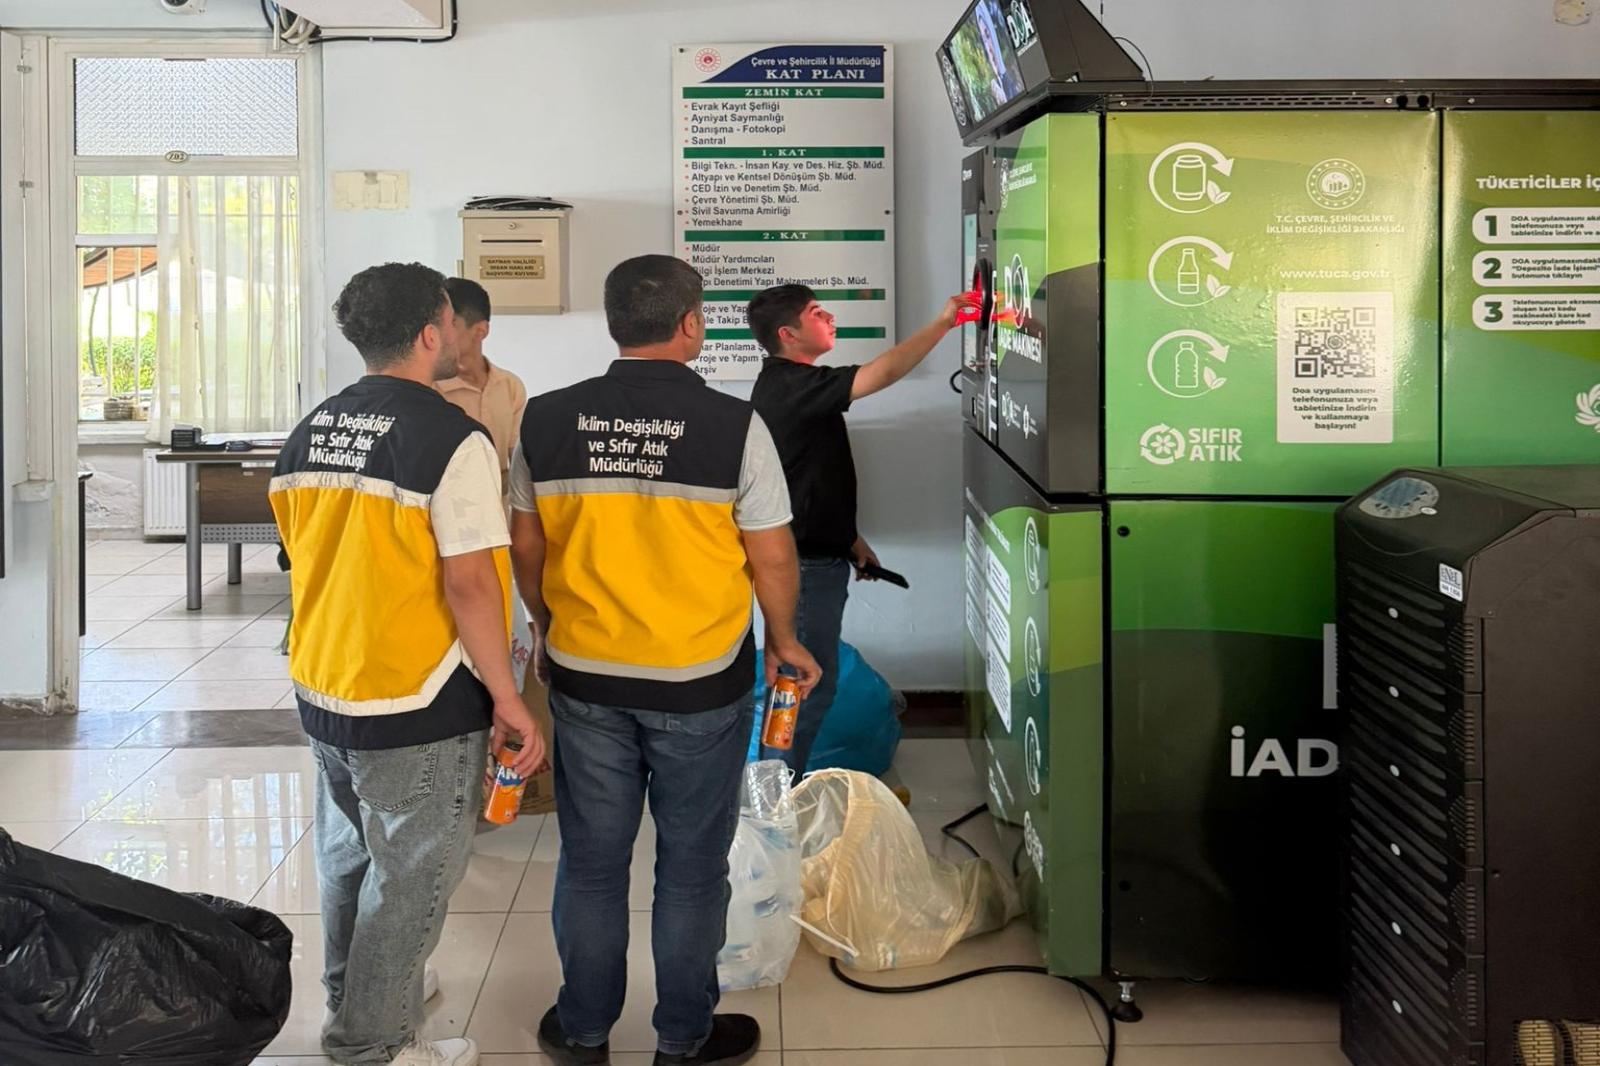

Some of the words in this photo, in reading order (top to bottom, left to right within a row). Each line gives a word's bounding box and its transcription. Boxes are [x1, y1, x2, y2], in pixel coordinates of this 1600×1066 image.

[751, 57, 775, 67] Çevre
[789, 57, 828, 67] Şehircilik
[836, 57, 881, 68] Müdürlüğü
[766, 69, 802, 79] KAT
[811, 69, 866, 79] PLANI
[745, 88, 790, 96] ZEMİN
[795, 88, 824, 96] KAT
[691, 102, 719, 111] Evrak
[721, 102, 747, 112] Kayıt
[749, 102, 780, 112] Şefliği
[691, 114, 728, 124] Ayniyat
[730, 113, 784, 123] Saymanlığı
[691, 125, 734, 135] Danışma
[743, 125, 786, 134] Fotokopi
[691, 136, 726, 145] Santral
[691, 161, 711, 172] Bilgi
[714, 161, 737, 170] Tekn.
[806, 161, 825, 169] Des.
[863, 161, 885, 169] Müd.
[691, 173, 723, 183] Altyapı
[737, 173, 771, 181] Kentsel
[773, 172, 816, 182] Dönüşüm
[835, 172, 856, 181] Müd.
[1476, 174, 1582, 190] TÜKETİCİLER
[744, 184, 781, 192] Denetim
[800, 184, 822, 192] Müd.
[691, 195, 718, 205] Çevre
[720, 195, 759, 204] Yönetimi
[778, 195, 799, 204] Müd.
[691, 206, 711, 215] Sivil
[713, 206, 754, 215] Savunma
[756, 206, 791, 216] Amirliği
[692, 218, 743, 227] Yemekhane
[1276, 215, 1294, 223] T.C.
[1330, 213, 1381, 224] ŞEHİRCİLİK
[1266, 225, 1293, 234] İKLİM
[1295, 224, 1351, 235] DEĞİŞİKLİĞİ
[1353, 224, 1405, 233] BAKANLIĞI
[1484, 215, 1497, 237] 1
[762, 232, 775, 240] 2.
[692, 244, 720, 252] Müdür
[692, 255, 721, 263] Müdür
[722, 255, 775, 263] Yardımcıları
[714, 265, 738, 276] İşlem
[740, 266, 775, 275] Merkezi
[1482, 257, 1502, 279] 2
[1280, 269, 1390, 280] www.tuca.gov.tr
[713, 277, 753, 286] Denetimi
[754, 277, 774, 287] Yapı
[847, 276, 869, 285] Müd.
[731, 304, 750, 315] Yap
[1483, 301, 1504, 323] 3
[717, 316, 740, 325] Takip
[715, 342, 756, 351] Planlama
[699, 354, 717, 364] roje
[731, 354, 759, 364] Yapım
[694, 365, 717, 375] Arşiv
[1293, 404, 1344, 412] tabletinize
[1315, 413, 1369, 422] kullanmaya
[337, 412, 396, 437] Değişikliği
[577, 413, 610, 432] İklim
[613, 418, 685, 440] Değişikliği
[311, 433, 326, 445] ve
[328, 432, 353, 448] Sıfır
[352, 434, 375, 451] Atık
[1188, 428, 1242, 444] SIFIR
[588, 440, 605, 452] ve
[608, 438, 638, 454] Sıfır
[642, 440, 668, 456] Atık
[308, 446, 367, 472] Müdürlüğü
[1189, 445, 1242, 462] ATIK
[589, 457, 664, 478] Müdürlüğü
[1230, 725, 1339, 778] İAD
